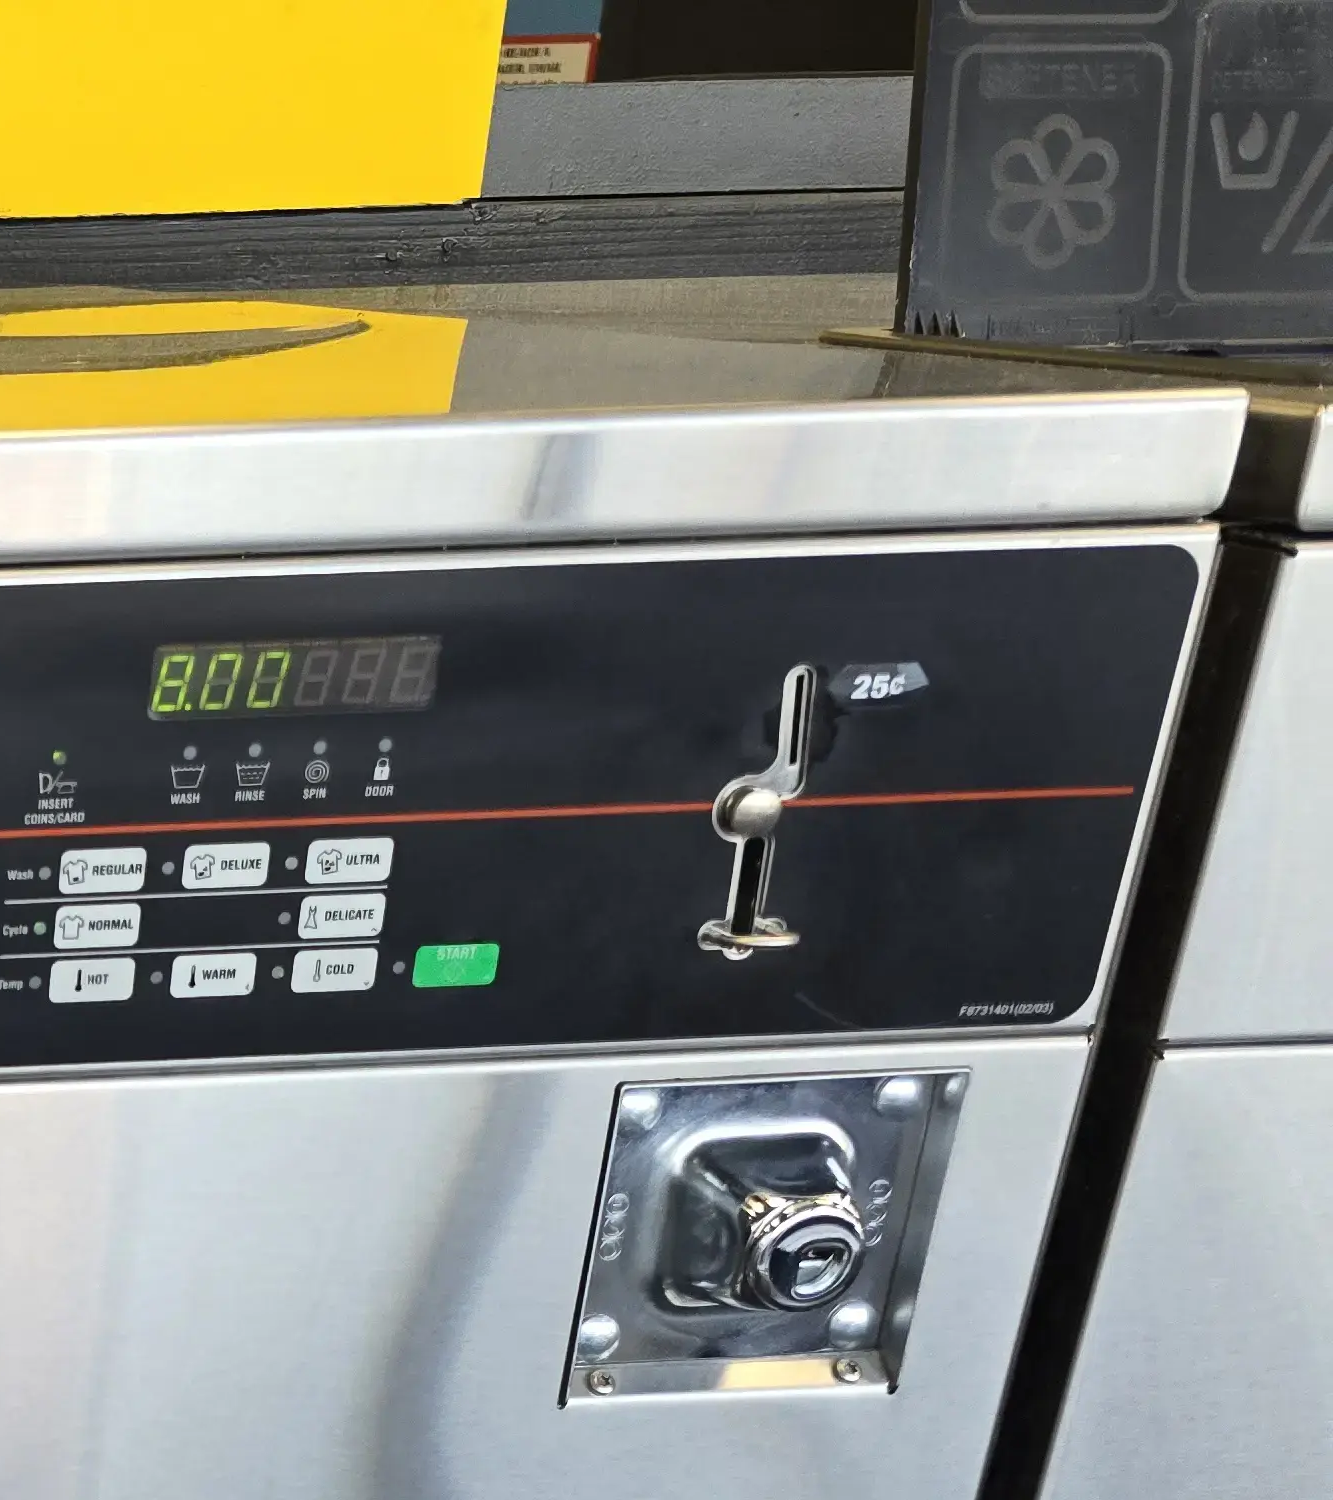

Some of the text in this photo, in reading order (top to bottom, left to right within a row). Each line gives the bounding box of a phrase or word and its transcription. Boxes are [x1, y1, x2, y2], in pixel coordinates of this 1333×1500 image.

[151, 652, 292, 713] 8.00
[850, 672, 906, 700] 25¢
[234, 789, 266, 802] RINSE
[302, 787, 327, 800] SPIN
[363, 785, 395, 798] DOOR
[37, 797, 75, 811] INSERT
[170, 792, 201, 805] WASH
[23, 811, 86, 826] COINS/CARD
[219, 858, 263, 871] DELUXE
[345, 853, 381, 866] ULTRA
[6, 868, 34, 881] Wash
[91, 863, 143, 877] REGULAR
[323, 908, 376, 922] DELICATE
[2, 925, 29, 938] Cycle
[88, 918, 134, 932] NORMAL
[436, 946, 477, 961] START
[201, 967, 237, 981] WARM
[325, 963, 355, 976] COLD
[87, 973, 110, 986] HOT
